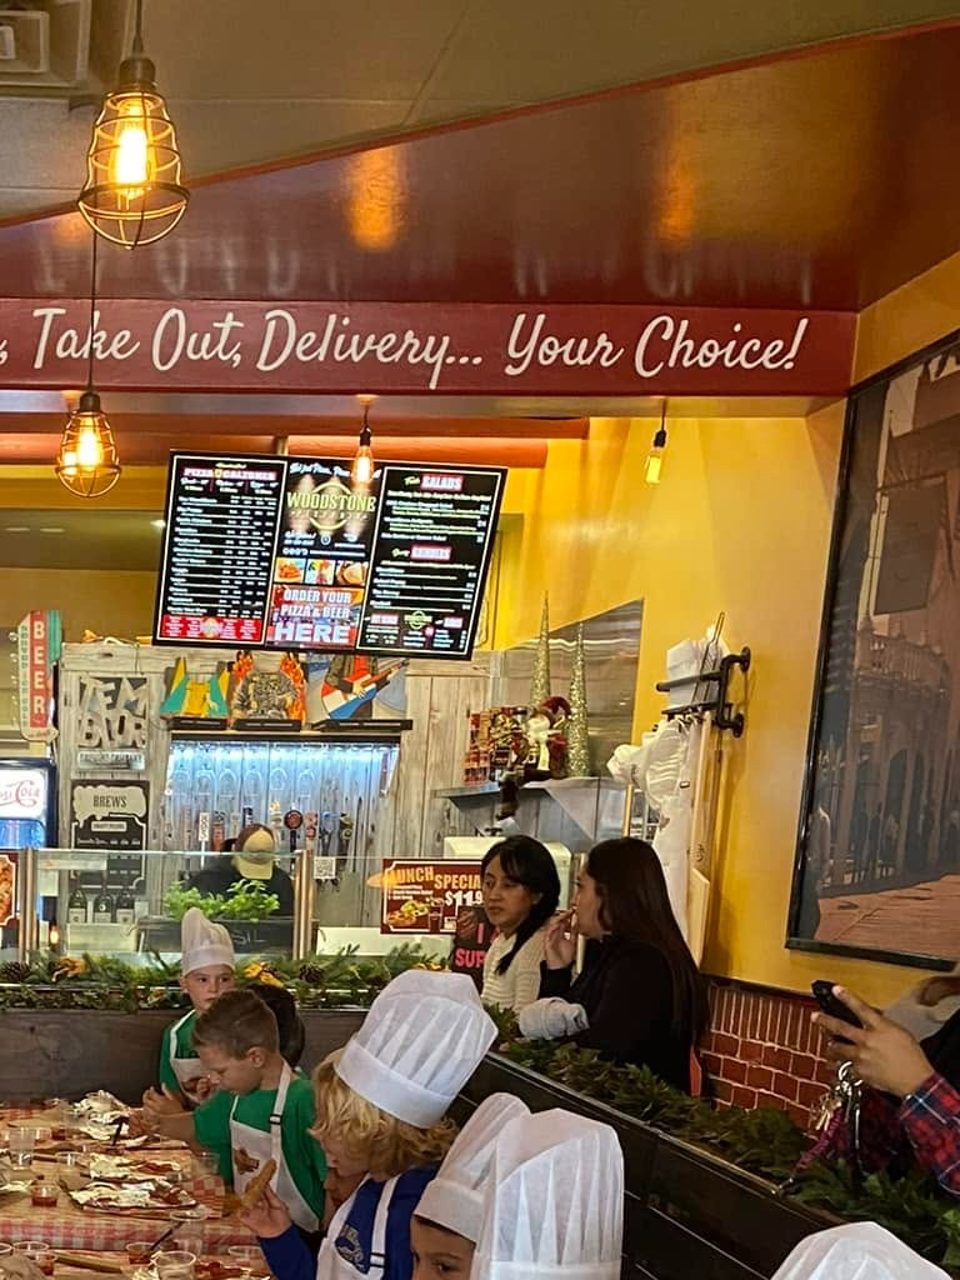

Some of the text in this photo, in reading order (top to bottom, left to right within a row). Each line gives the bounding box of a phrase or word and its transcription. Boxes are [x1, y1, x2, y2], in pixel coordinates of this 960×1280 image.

[32, 307, 140, 369] Take
[151, 307, 245, 372] Out,
[256, 309, 483, 390] Delivery...
[505, 313, 625, 376] Your
[635, 315, 809, 378] Choice!
[283, 588, 352, 604] ORDER YOUR
[280, 604, 311, 617] PIZZA
[275, 621, 350, 643] HERE
[33, 620, 46, 716] BEER
